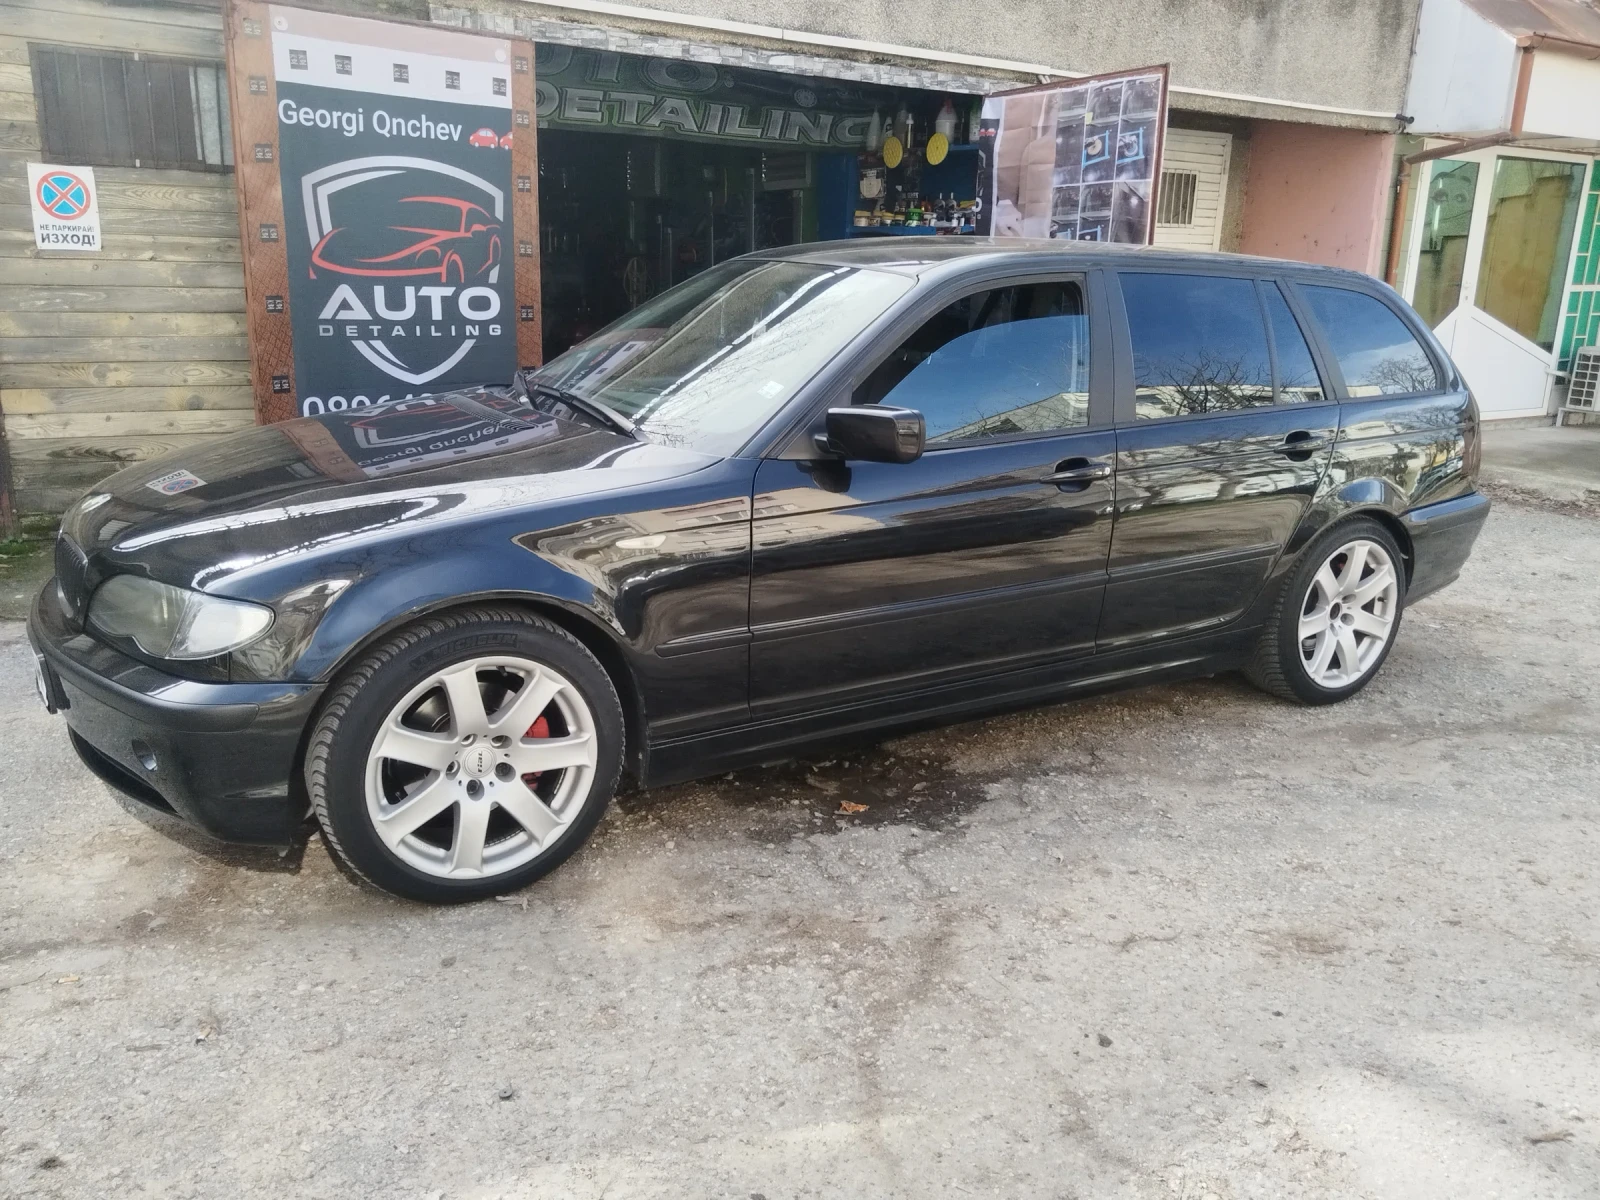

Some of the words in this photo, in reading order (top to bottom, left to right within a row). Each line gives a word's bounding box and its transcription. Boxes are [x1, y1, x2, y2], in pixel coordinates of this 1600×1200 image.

[278, 99, 364, 137] Georgi
[372, 110, 462, 142] Qnchev
[41, 233, 95, 246] ИЗХОД!
[318, 284, 501, 321] AUTO
[319, 324, 502, 337] DETAILING
